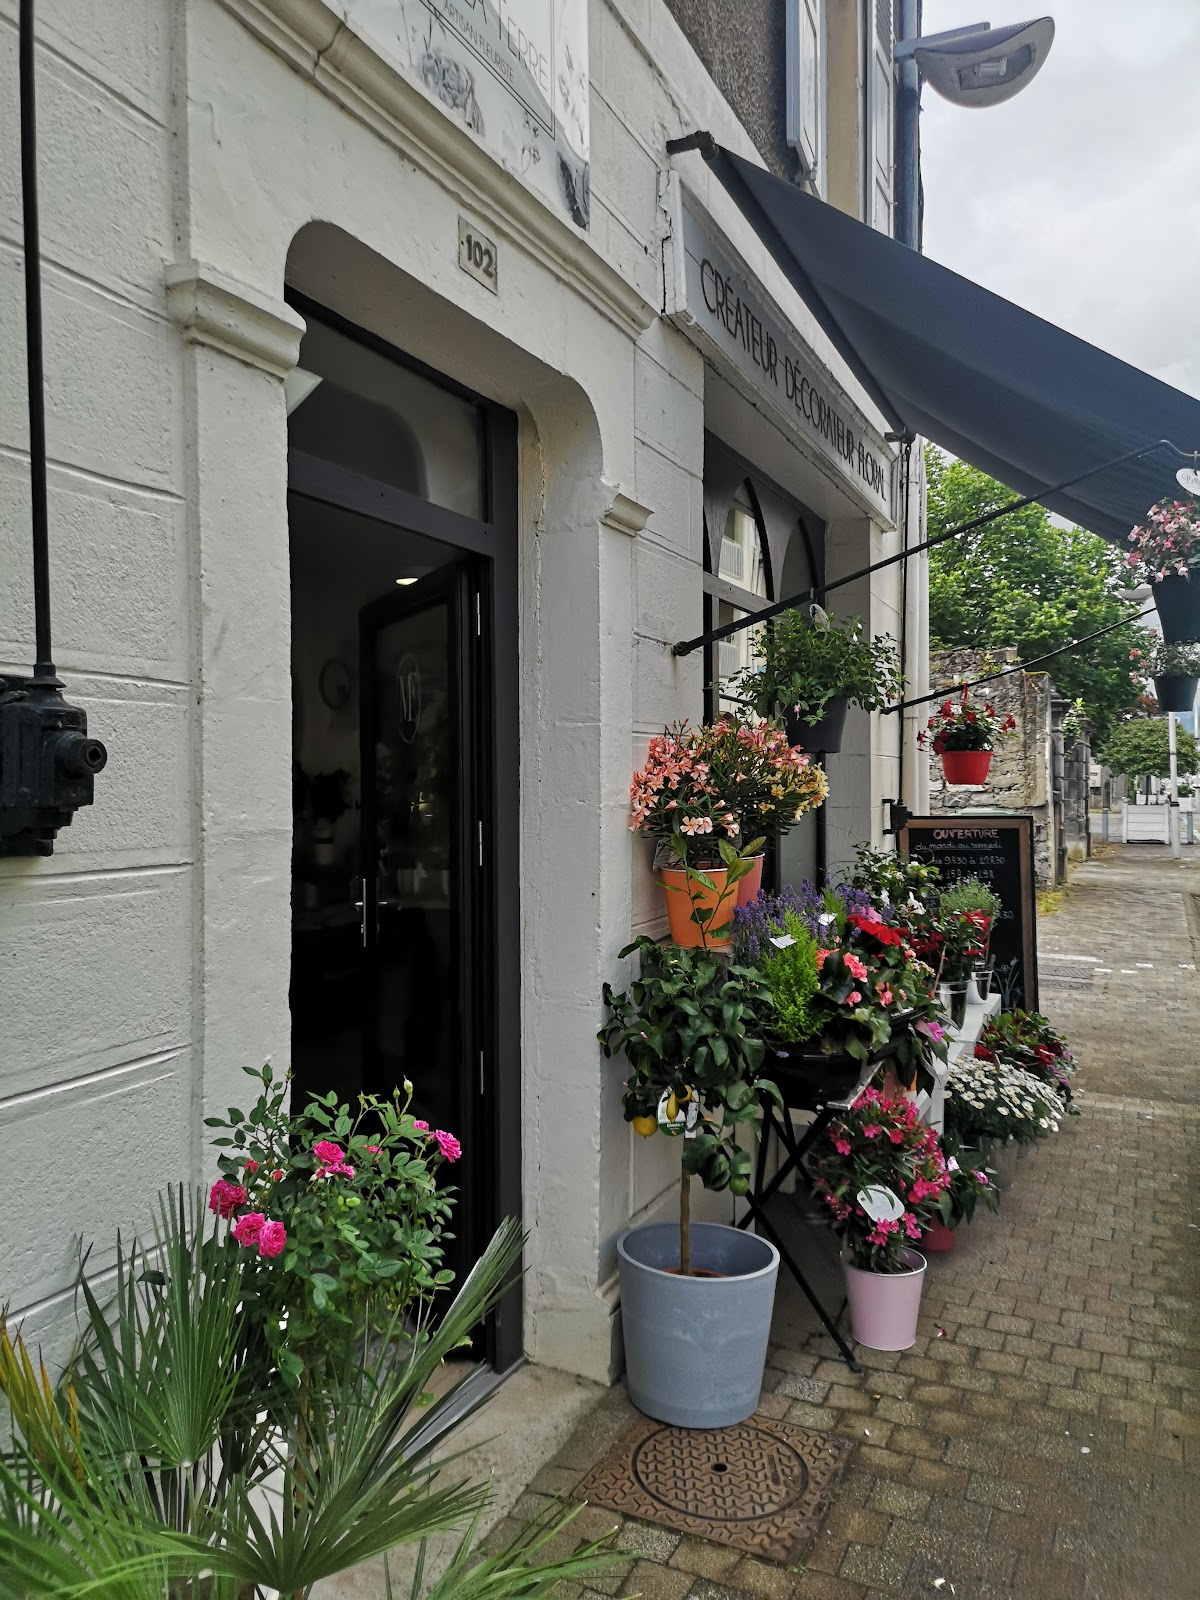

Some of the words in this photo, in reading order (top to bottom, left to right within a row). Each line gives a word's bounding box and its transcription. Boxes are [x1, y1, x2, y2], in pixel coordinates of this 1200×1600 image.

[444, 0, 478, 45] ARTISAN
[479, 34, 514, 84] FLEURISTE
[466, 234, 494, 278] 102
[700, 258, 778, 387] CRÉATEUR
[784, 355, 854, 468] DÉCORATEUR
[858, 441, 887, 502] FLORAL
[932, 828, 1000, 840] OUVERTURE
[971, 841, 1002, 849] samedi
